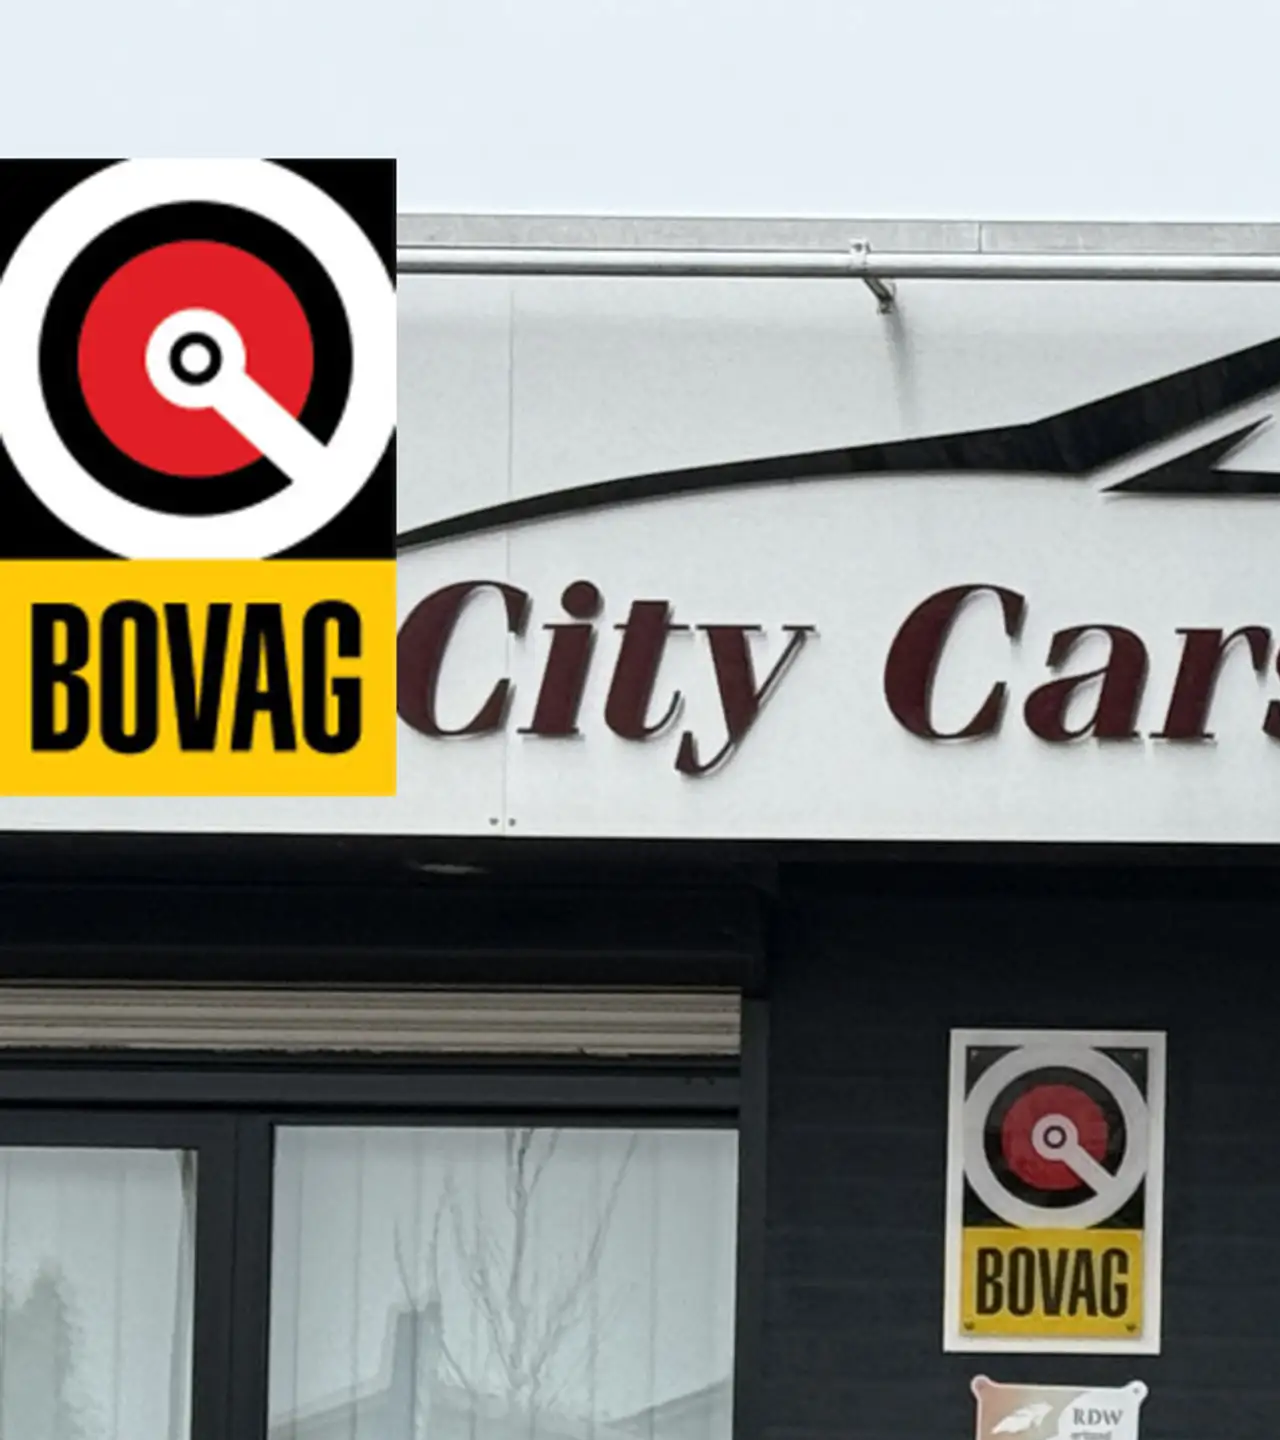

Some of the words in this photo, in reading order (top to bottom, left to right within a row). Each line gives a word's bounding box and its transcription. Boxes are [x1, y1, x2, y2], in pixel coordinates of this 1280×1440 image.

[397, 580, 815, 777] City
[974, 1246, 1130, 1319] BOVAG
[1072, 1408, 1124, 1426] RDW
